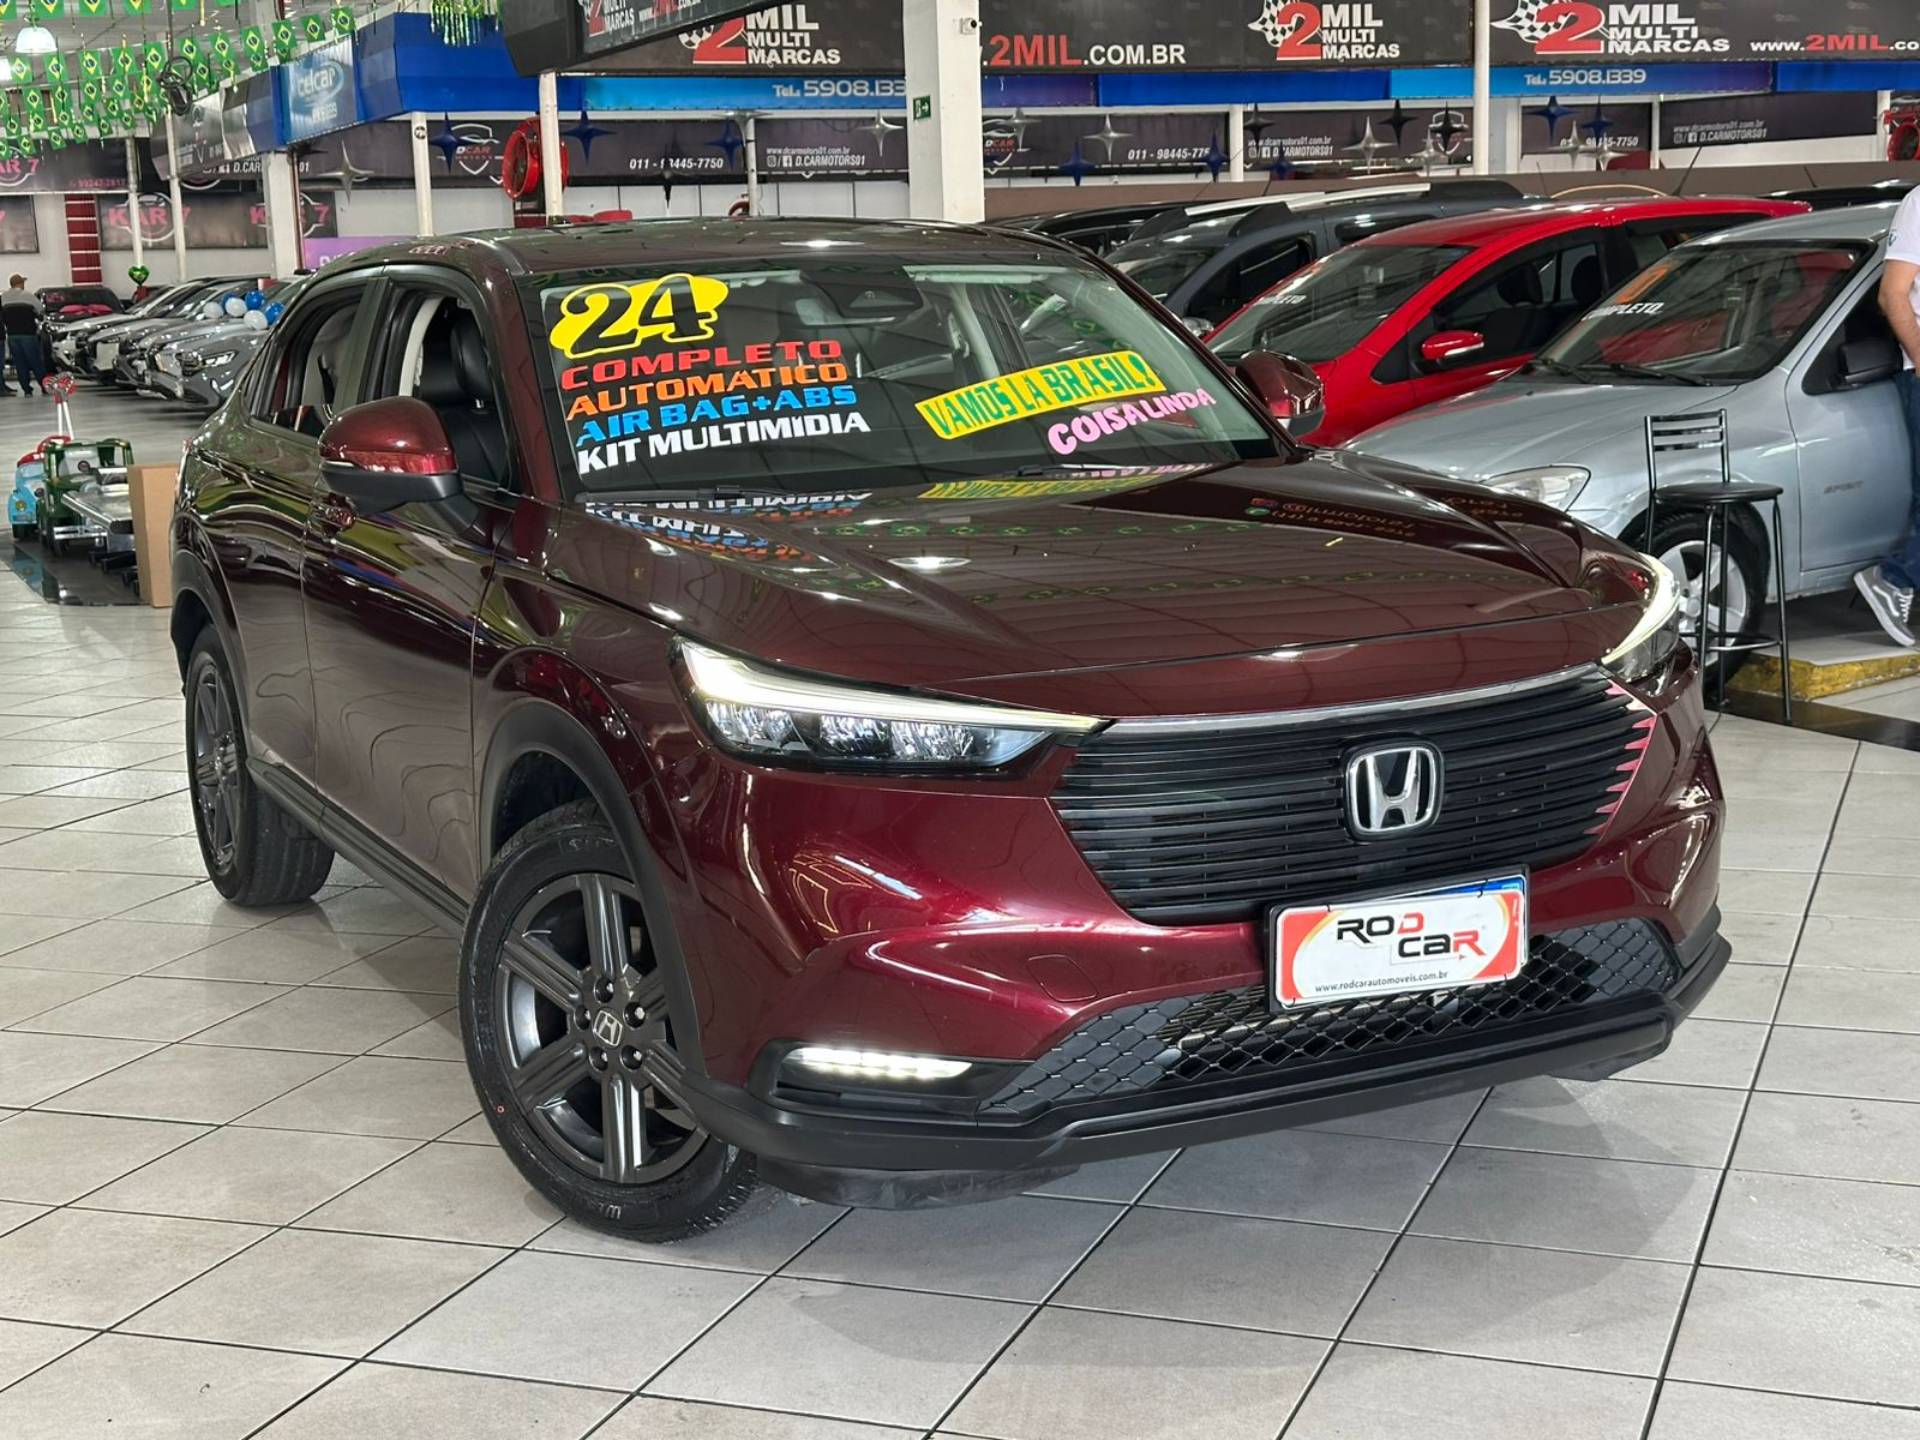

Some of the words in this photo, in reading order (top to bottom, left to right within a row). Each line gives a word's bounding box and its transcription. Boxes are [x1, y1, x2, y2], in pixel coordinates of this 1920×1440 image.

[605, 8, 635, 31] MARCAS
[746, 4, 820, 31] MIL
[1534, 1, 1605, 54] 2
[1607, 3, 1696, 25] MIL
[748, 31, 811, 47] MULTI
[1276, 1, 1321, 61] 2
[1321, 3, 1384, 28] MIL
[1321, 28, 1376, 44] MULTI
[1608, 26, 1699, 40] MULTI
[748, 49, 841, 65] MARCAS
[980, 34, 1187, 67] .2MIL.COM.BR
[1321, 44, 1400, 59] MARCAS
[1607, 39, 1731, 54] MARCAS
[1549, 68, 1647, 85] 5908.1339
[1128, 149, 1147, 160] 011
[1273, 145, 1333, 158] D.ARMOTORS01
[629, 158, 650, 169] 011
[561, 273, 718, 359] 24
[561, 339, 842, 391] COMPLETO
[923, 382, 1014, 436] VAMOS
[1008, 368, 1051, 412] LA
[1042, 353, 1156, 403] BRASIL!
[576, 408, 652, 448] AIR
[660, 385, 857, 427] BAG+ABS
[1047, 406, 1148, 455] COISA
[1139, 387, 1217, 419] LINDA
[578, 438, 642, 475] KIT
[1337, 912, 1425, 944] ROD
[1315, 970, 1449, 993] www.rodcarautomoveis.com.br
